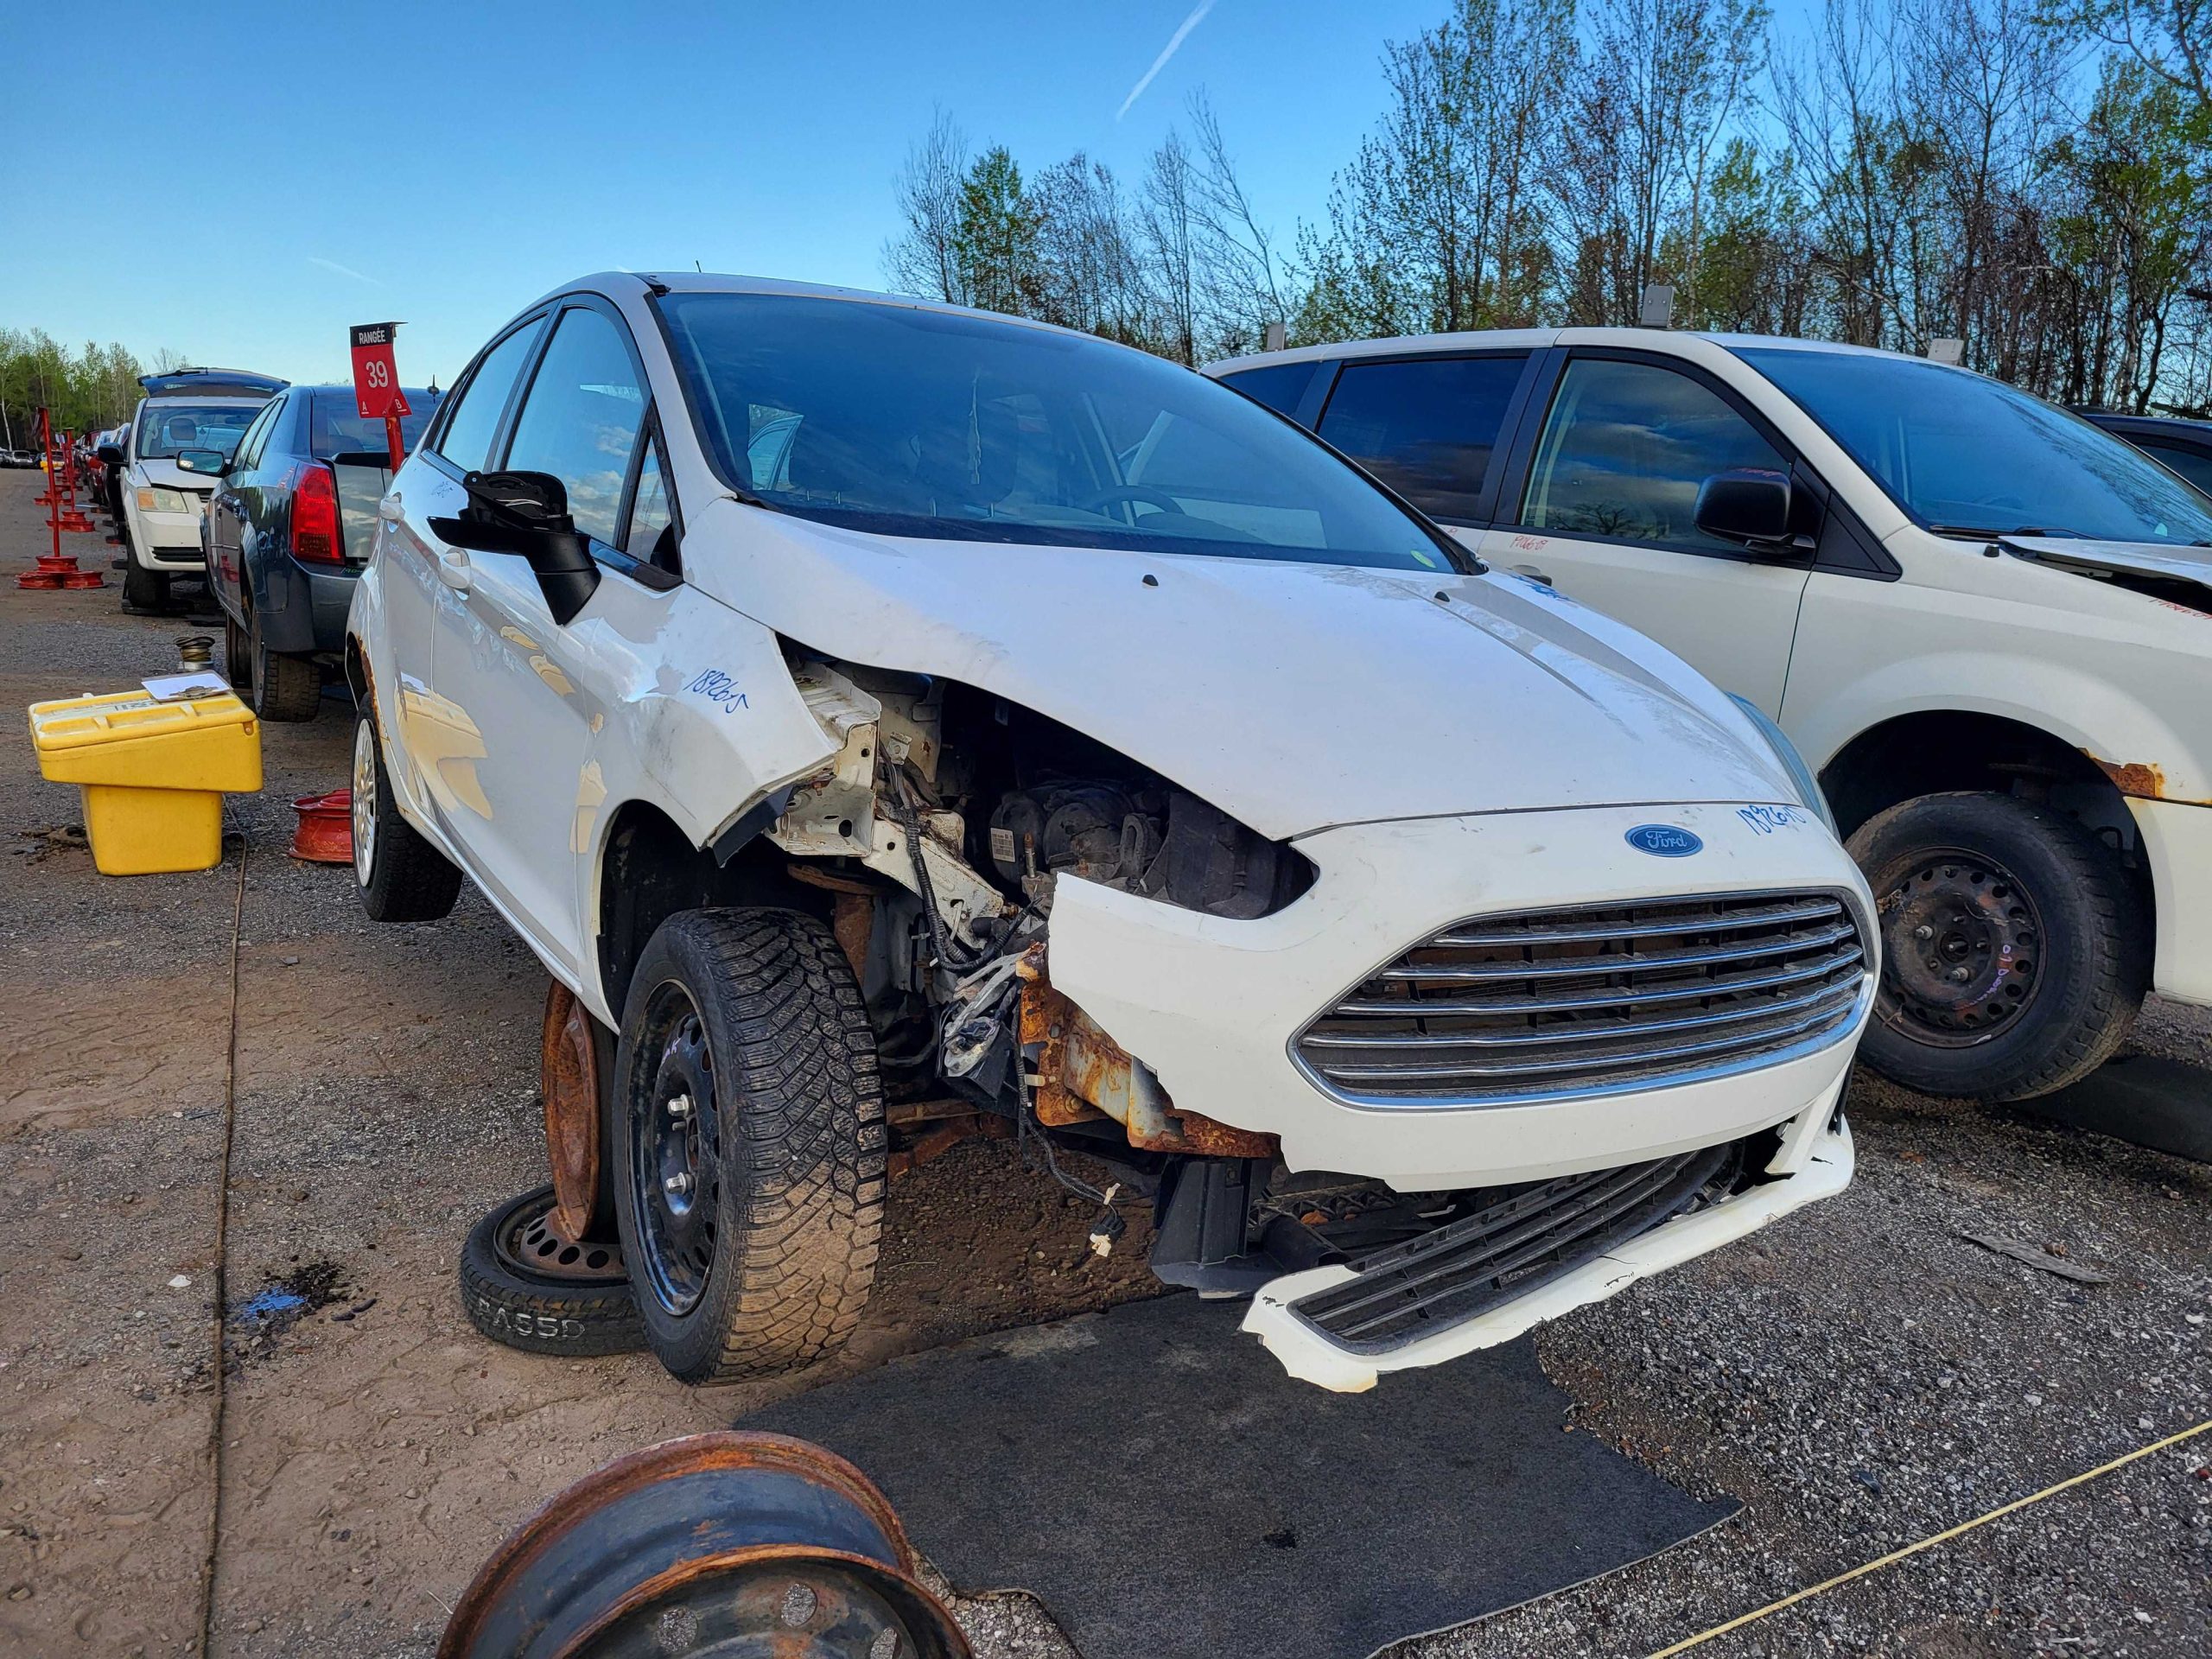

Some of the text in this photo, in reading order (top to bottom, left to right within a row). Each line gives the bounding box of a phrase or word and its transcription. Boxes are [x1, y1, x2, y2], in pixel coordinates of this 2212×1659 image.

[359, 327, 385, 344] RANGÉE
[365, 360, 389, 388] 39
[362, 401, 367, 411] A
[394, 398, 403, 410] B
[1647, 830, 1688, 849] Ford
